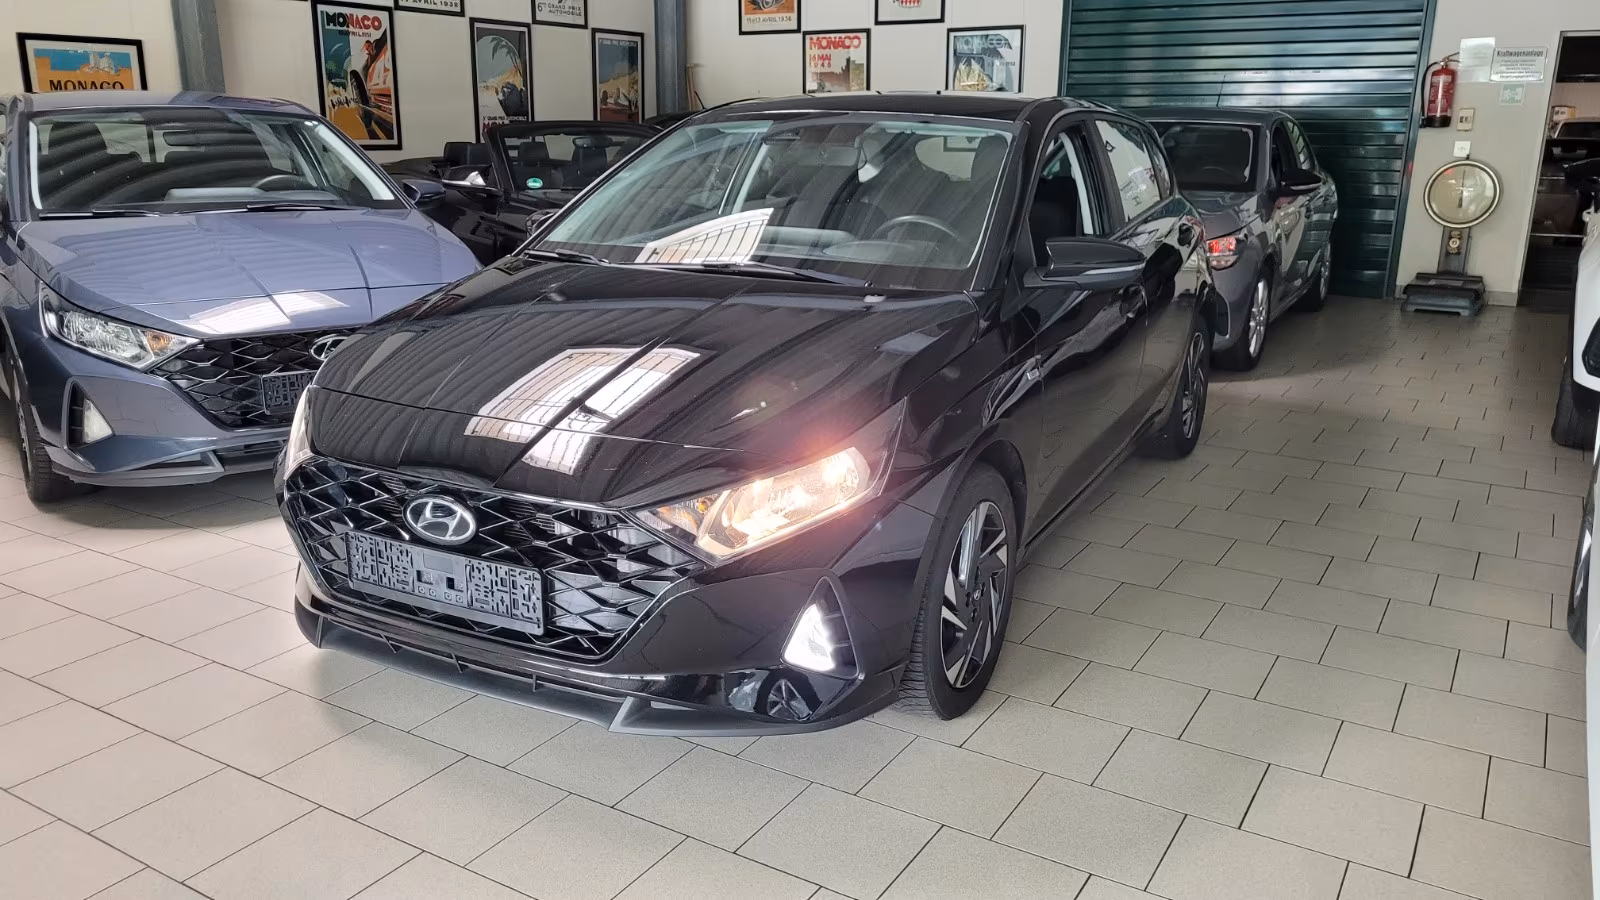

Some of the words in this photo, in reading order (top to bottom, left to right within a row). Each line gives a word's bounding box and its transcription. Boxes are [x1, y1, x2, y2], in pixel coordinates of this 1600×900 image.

[325, 10, 382, 31] MONACO
[809, 35, 862, 50] MONACO
[954, 35, 1006, 54] MONACO
[49, 79, 125, 91] MONACO
